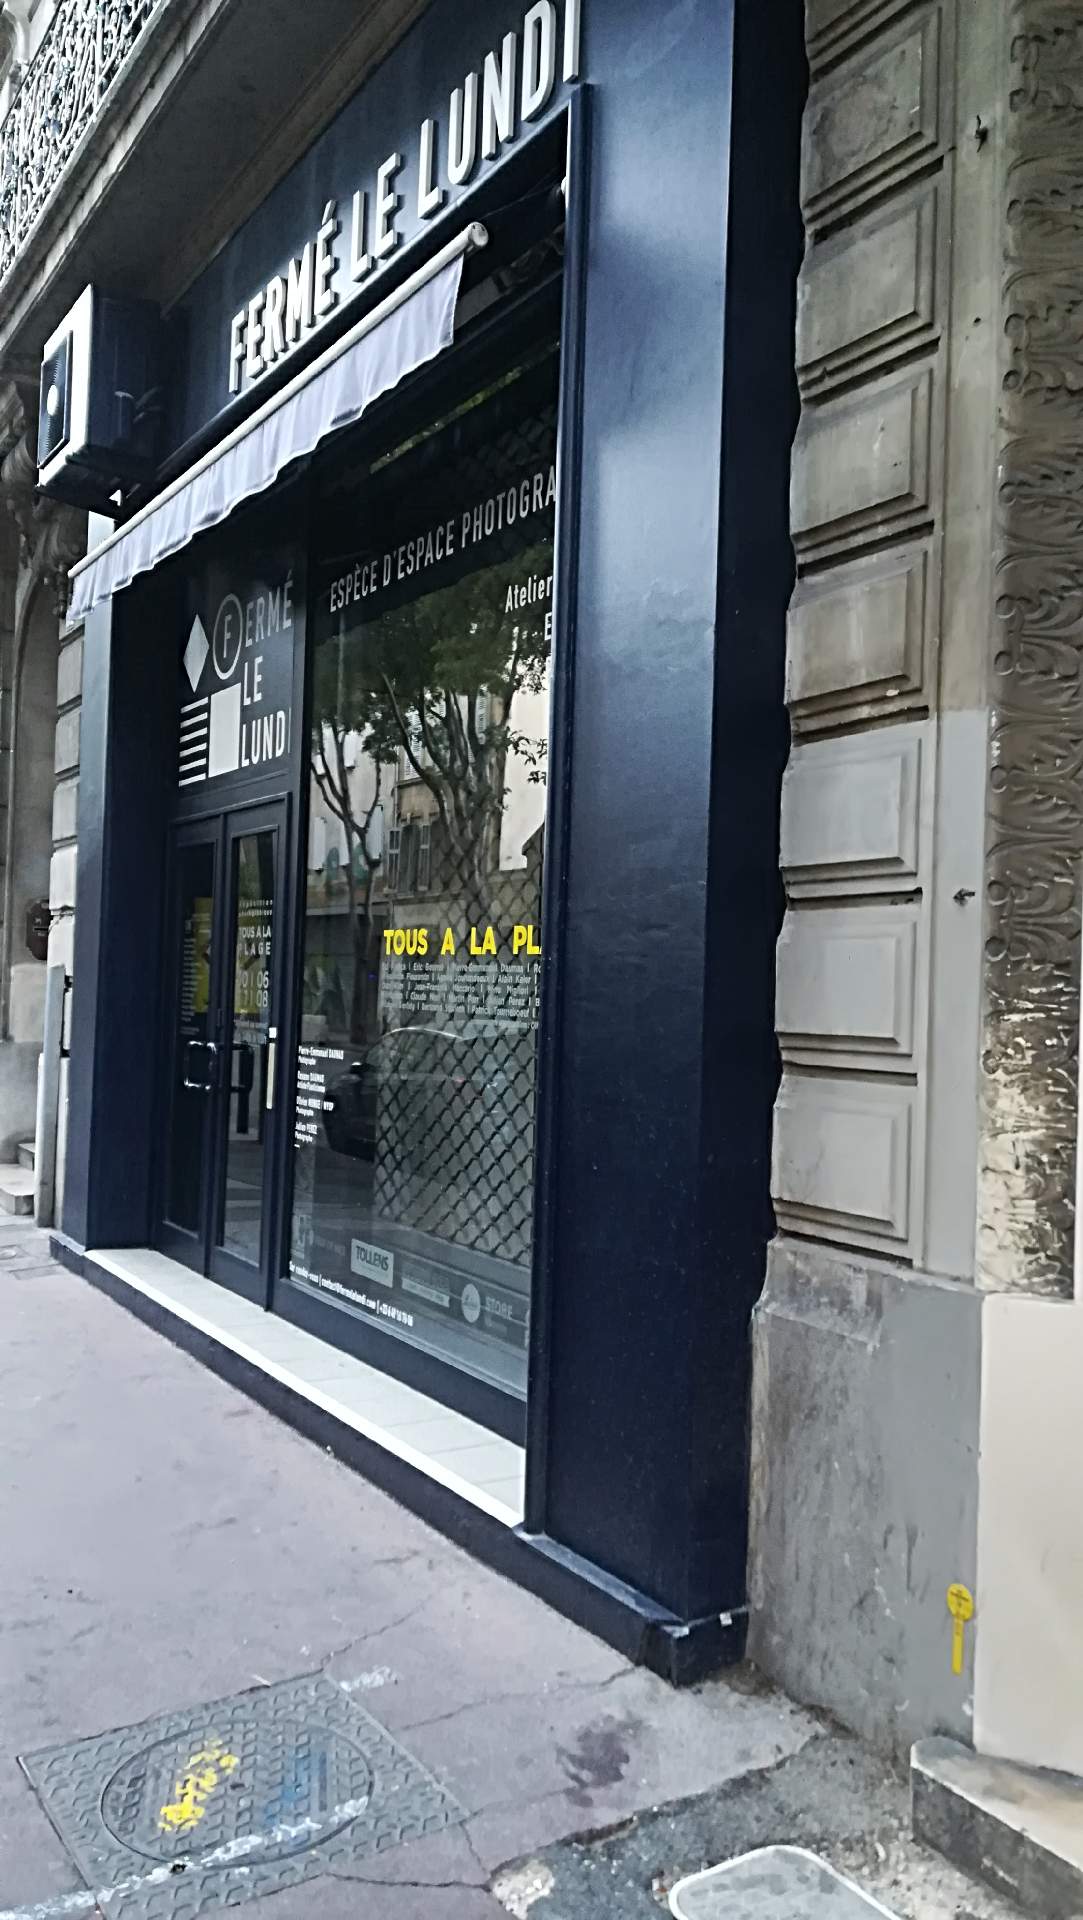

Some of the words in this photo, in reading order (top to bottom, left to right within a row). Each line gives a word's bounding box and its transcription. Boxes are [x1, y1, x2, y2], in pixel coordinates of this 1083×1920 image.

[229, 200, 337, 393] FERMÉ
[351, 153, 400, 282] LE
[418, 0, 580, 219] LUNDI
[330, 562, 377, 613] ESPÈCE
[383, 520, 454, 587] D'ESPACE
[505, 574, 553, 613] Atelier
[243, 656, 263, 705] LE
[262, 925, 272, 938] LA
[384, 928, 428, 955] TOUS
[441, 927, 455, 955] A
[470, 926, 497, 955] LA
[512, 925, 542, 954] PL
[355, 1245, 389, 1272] TOLLENS
